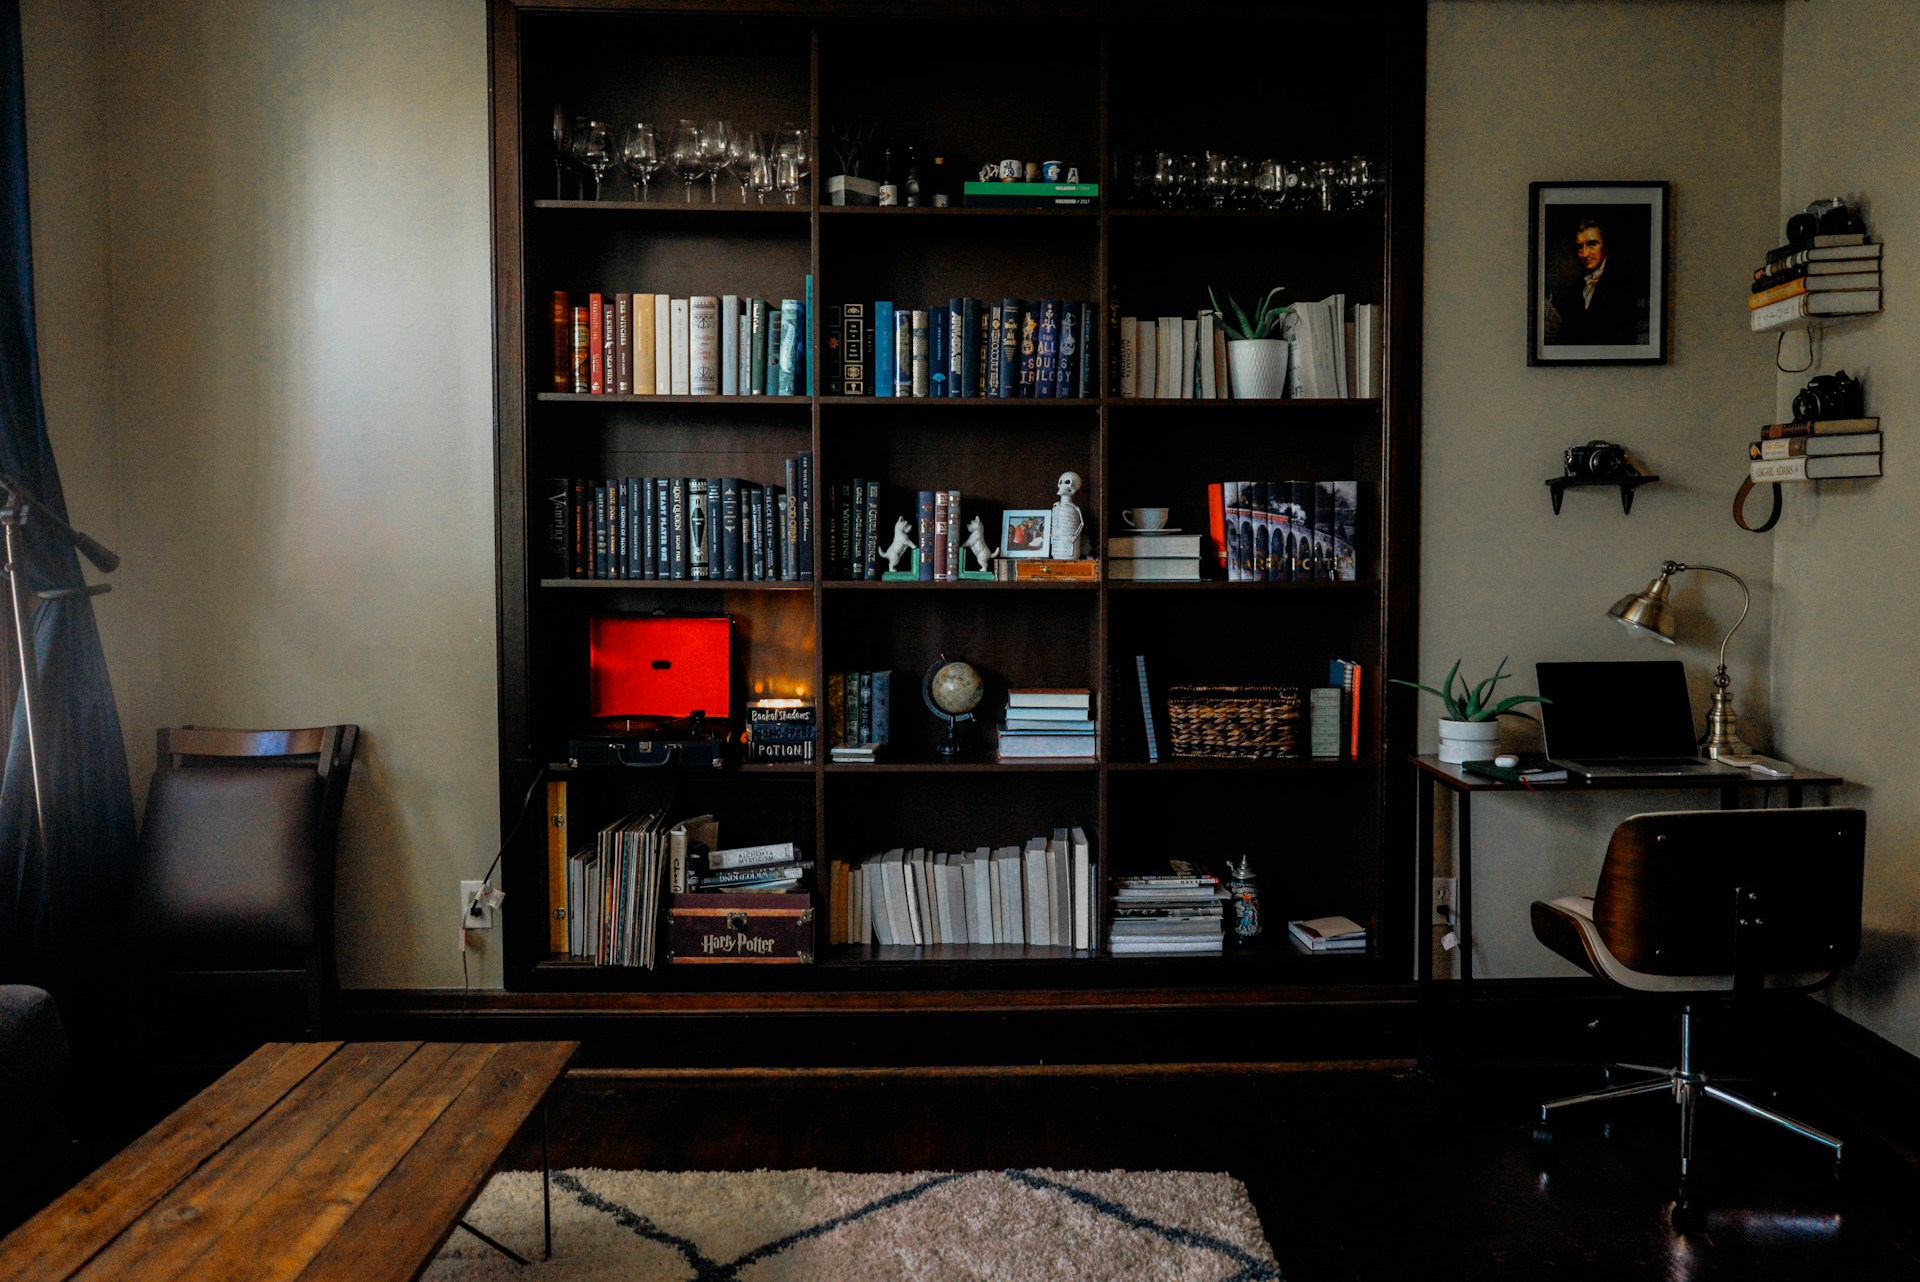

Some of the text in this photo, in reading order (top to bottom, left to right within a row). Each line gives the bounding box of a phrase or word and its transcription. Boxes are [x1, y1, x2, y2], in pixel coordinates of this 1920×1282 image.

[951, 311, 962, 357] ARMADA
[990, 343, 999, 372] OCCULT
[1037, 341, 1057, 354] ALL
[1020, 369, 1072, 385] TRILOGY
[659, 490, 667, 516] READY
[673, 485, 682, 531] LOST QUEEN
[788, 495, 797, 519] GOOD
[659, 516, 667, 545] PLAYER
[765, 518, 773, 537] ARTS
[842, 508, 850, 559] WICKED KING
[868, 509, 878, 563] CRUEL PRINCE
[659, 546, 668, 562] ONE
[758, 744, 803, 757] POTION
[738, 851, 769, 859] ALCHEMY
[738, 855, 774, 864] MYSTICISM
[719, 873, 738, 883] KING
[740, 871, 769, 881] WICKED
[701, 932, 775, 954] Harry Potter
